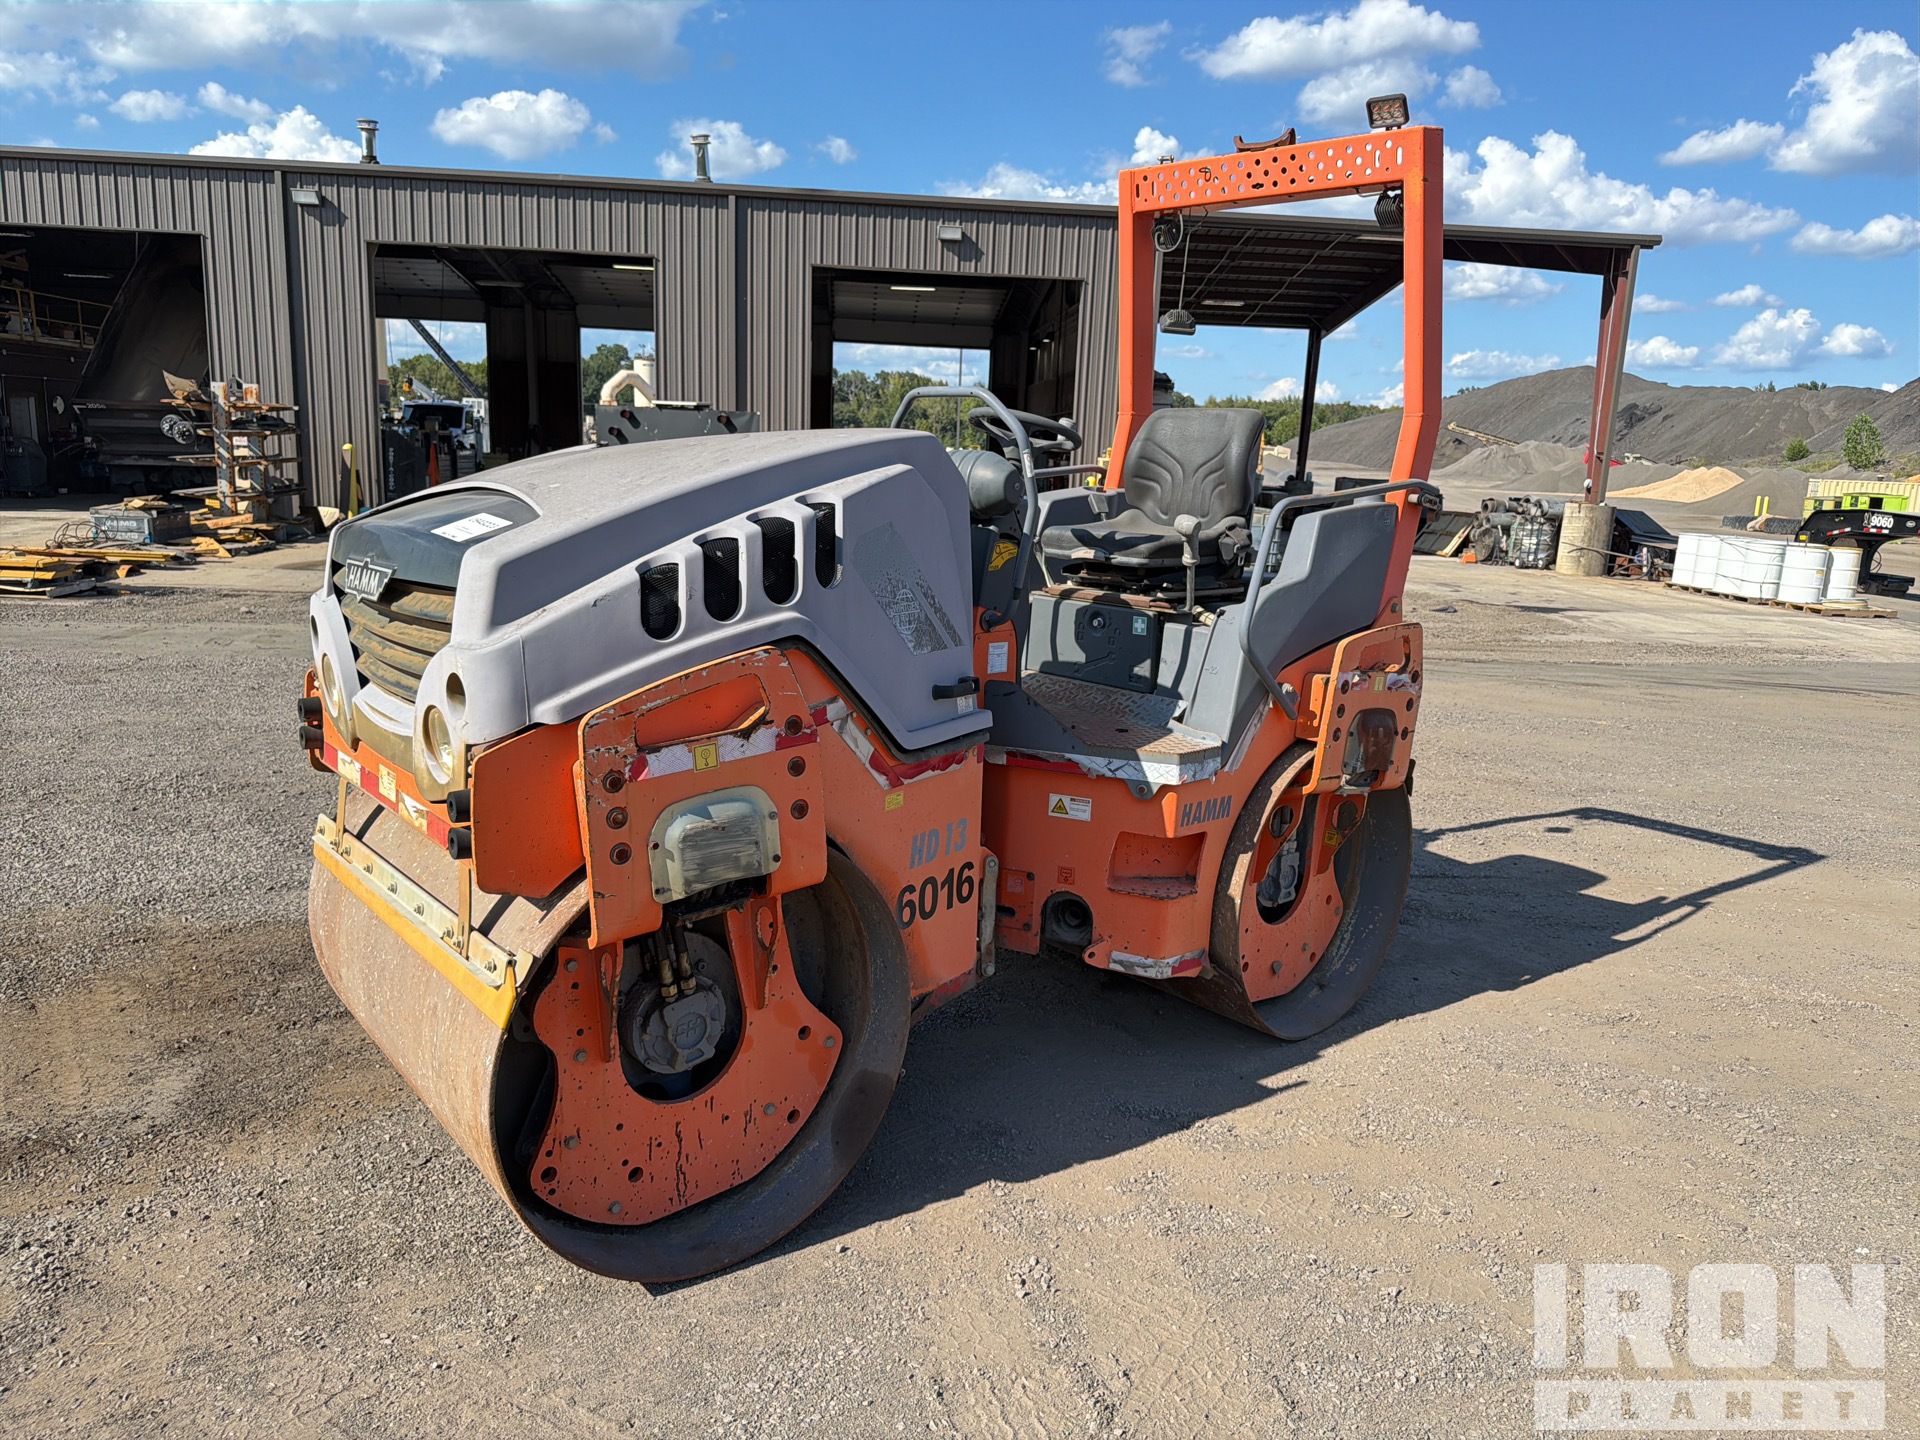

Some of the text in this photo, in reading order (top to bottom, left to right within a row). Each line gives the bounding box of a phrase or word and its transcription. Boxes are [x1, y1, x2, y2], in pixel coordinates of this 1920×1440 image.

[1871, 516, 1894, 528] 9060
[347, 565, 380, 594] HAMM
[1180, 795, 1232, 827] HAMM
[909, 818, 968, 869] HD 13
[896, 861, 975, 930] 6016
